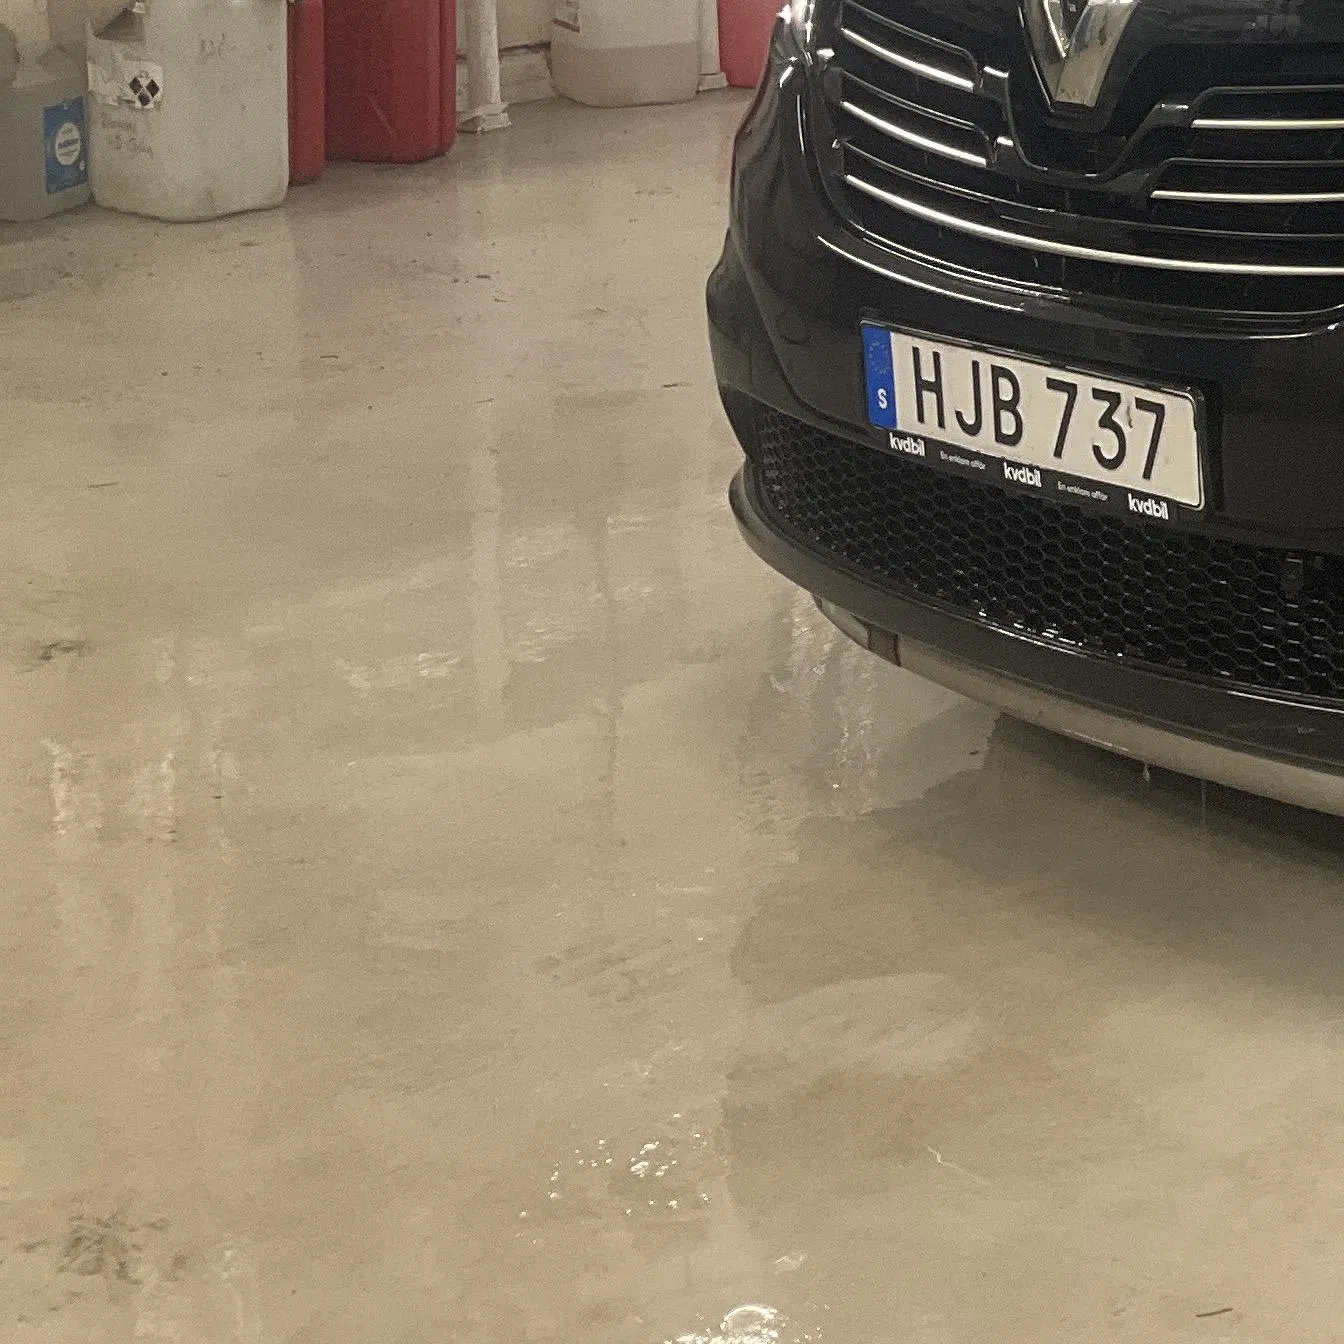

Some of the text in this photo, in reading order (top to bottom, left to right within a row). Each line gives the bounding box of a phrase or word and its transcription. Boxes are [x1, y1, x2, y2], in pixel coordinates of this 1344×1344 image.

[877, 388, 888, 409] S
[911, 346, 1166, 480] HJB 737
[889, 432, 926, 456] kvdbil
[1003, 461, 1042, 488] kvdbil
[1127, 492, 1169, 520] kvdbil
